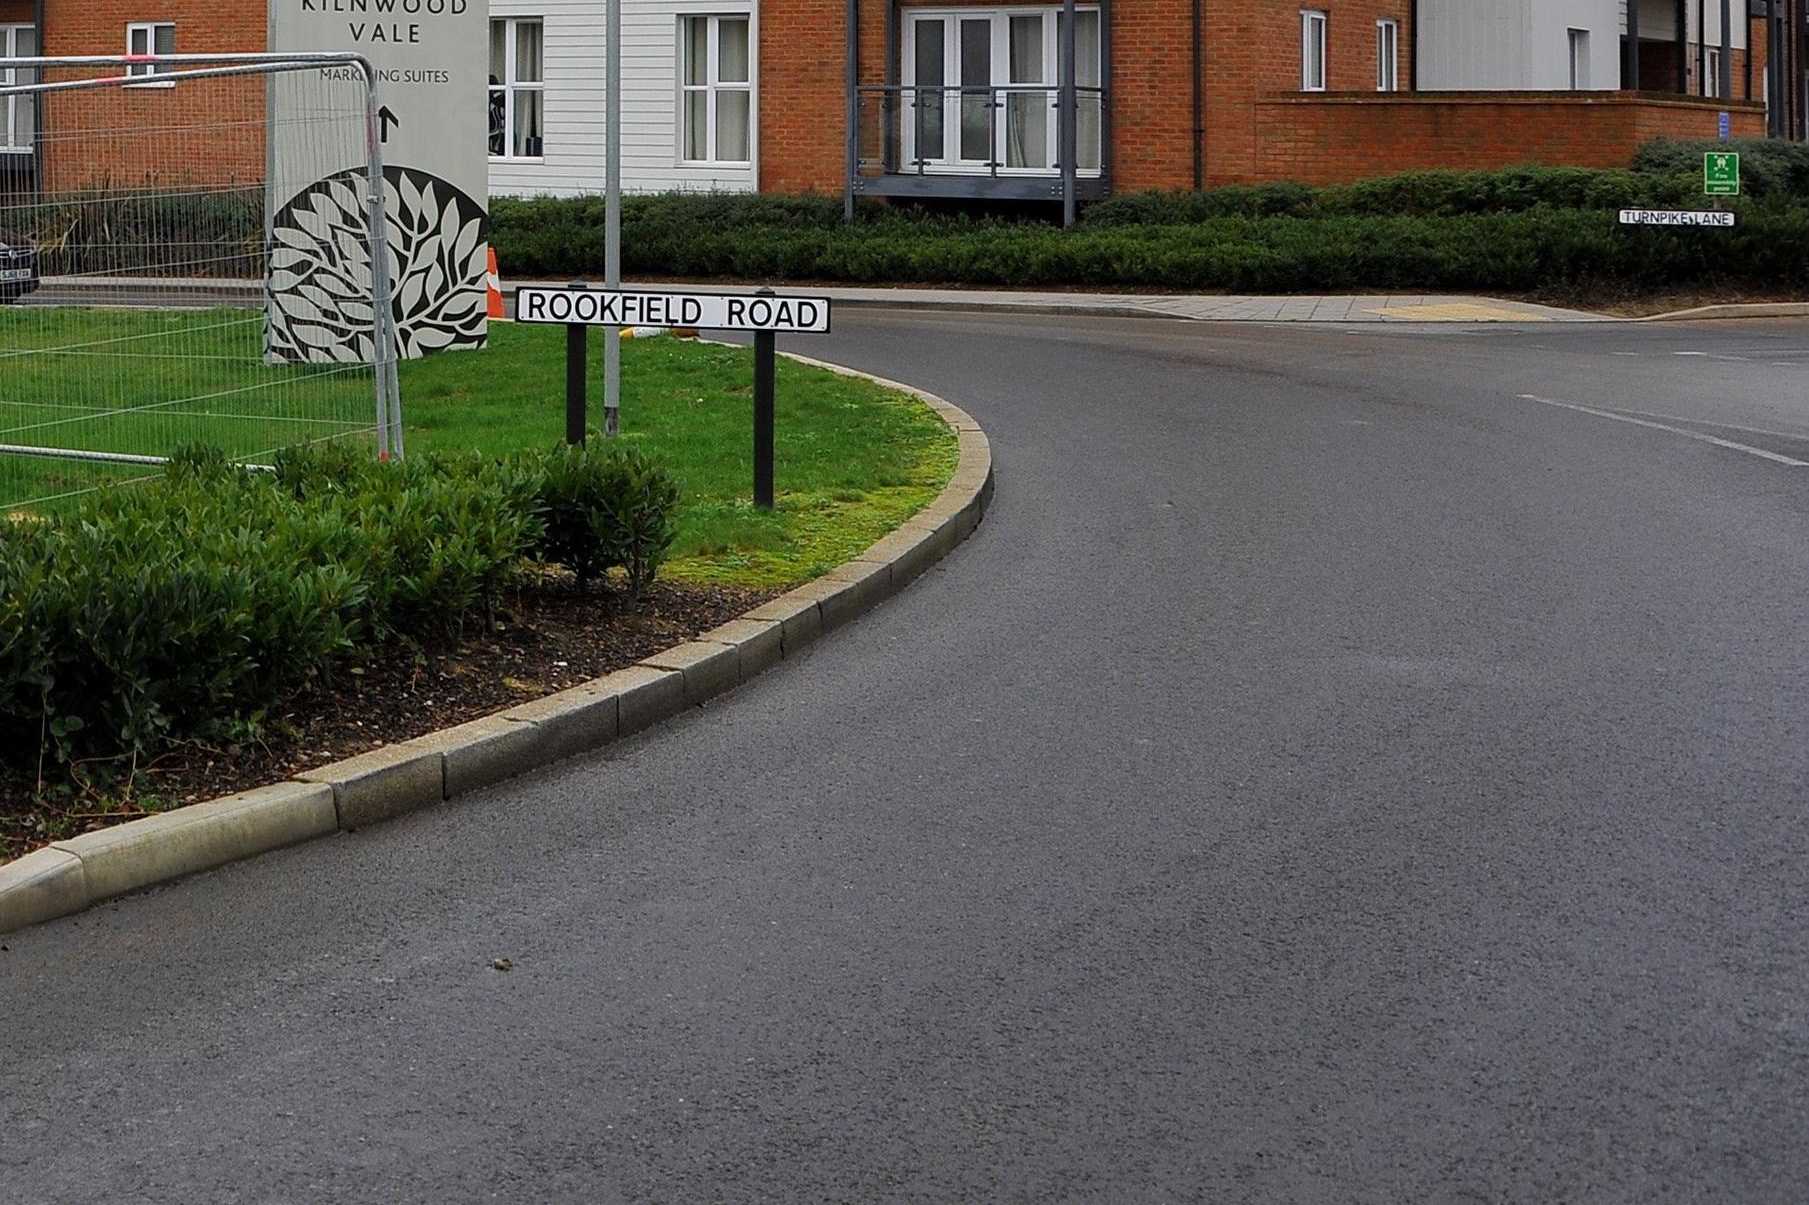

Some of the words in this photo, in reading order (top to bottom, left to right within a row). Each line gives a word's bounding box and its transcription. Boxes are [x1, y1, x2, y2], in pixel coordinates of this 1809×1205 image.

[349, 22, 420, 43] VALE
[320, 68, 400, 83] MARKING
[403, 69, 449, 84] SUITES
[1624, 211, 1688, 224] TURNPIKE
[1694, 212, 1730, 226] LANE
[528, 292, 702, 325] ROOKFIELD
[727, 298, 819, 328] ROAD
